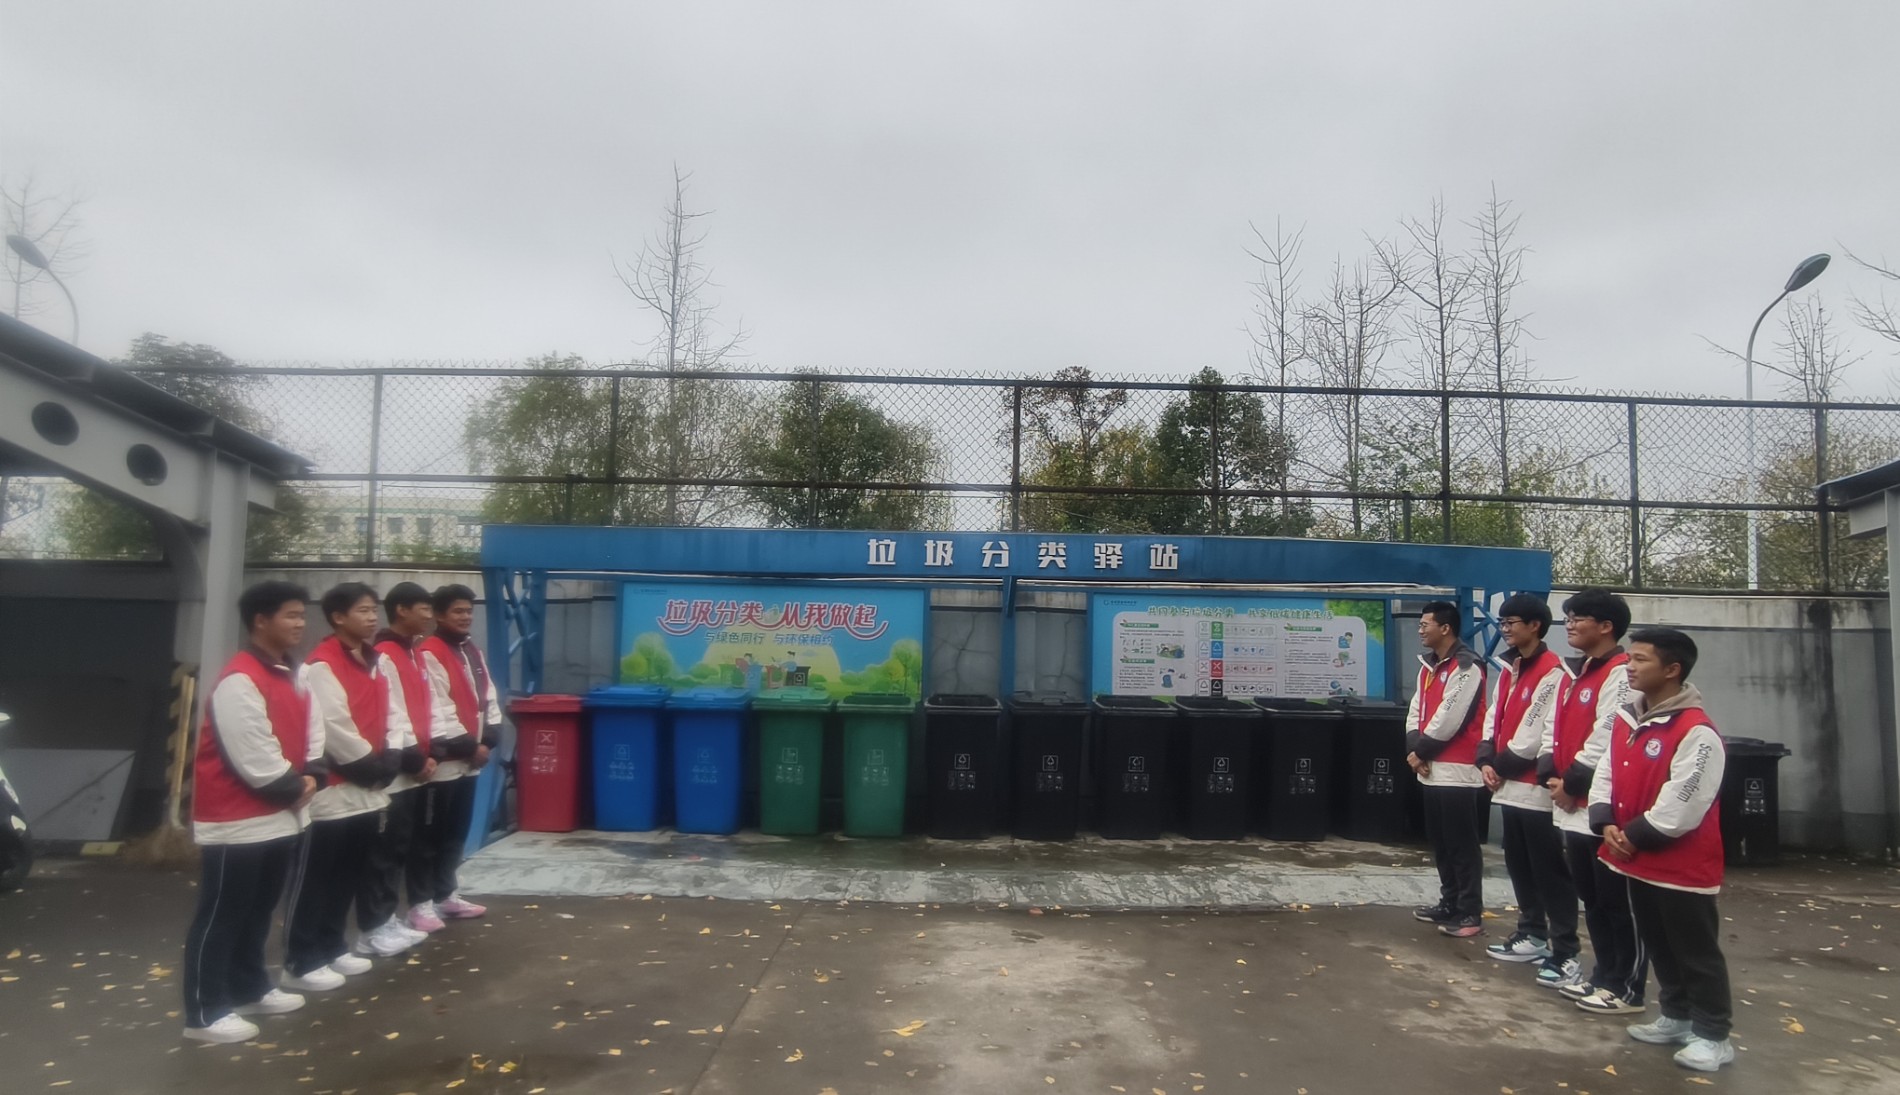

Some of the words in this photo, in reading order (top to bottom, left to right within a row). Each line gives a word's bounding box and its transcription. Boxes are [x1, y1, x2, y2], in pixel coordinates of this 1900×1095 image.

[867, 538, 1179, 570] 垃圾分类驿站
[665, 599, 764, 627] 垃圾分类
[781, 602, 877, 629] 从我做起
[704, 632, 764, 645] 与绿色同行
[773, 633, 834, 646] 与环保相约
[1695, 743, 1713, 774] School
[1676, 771, 1702, 803] uniform
